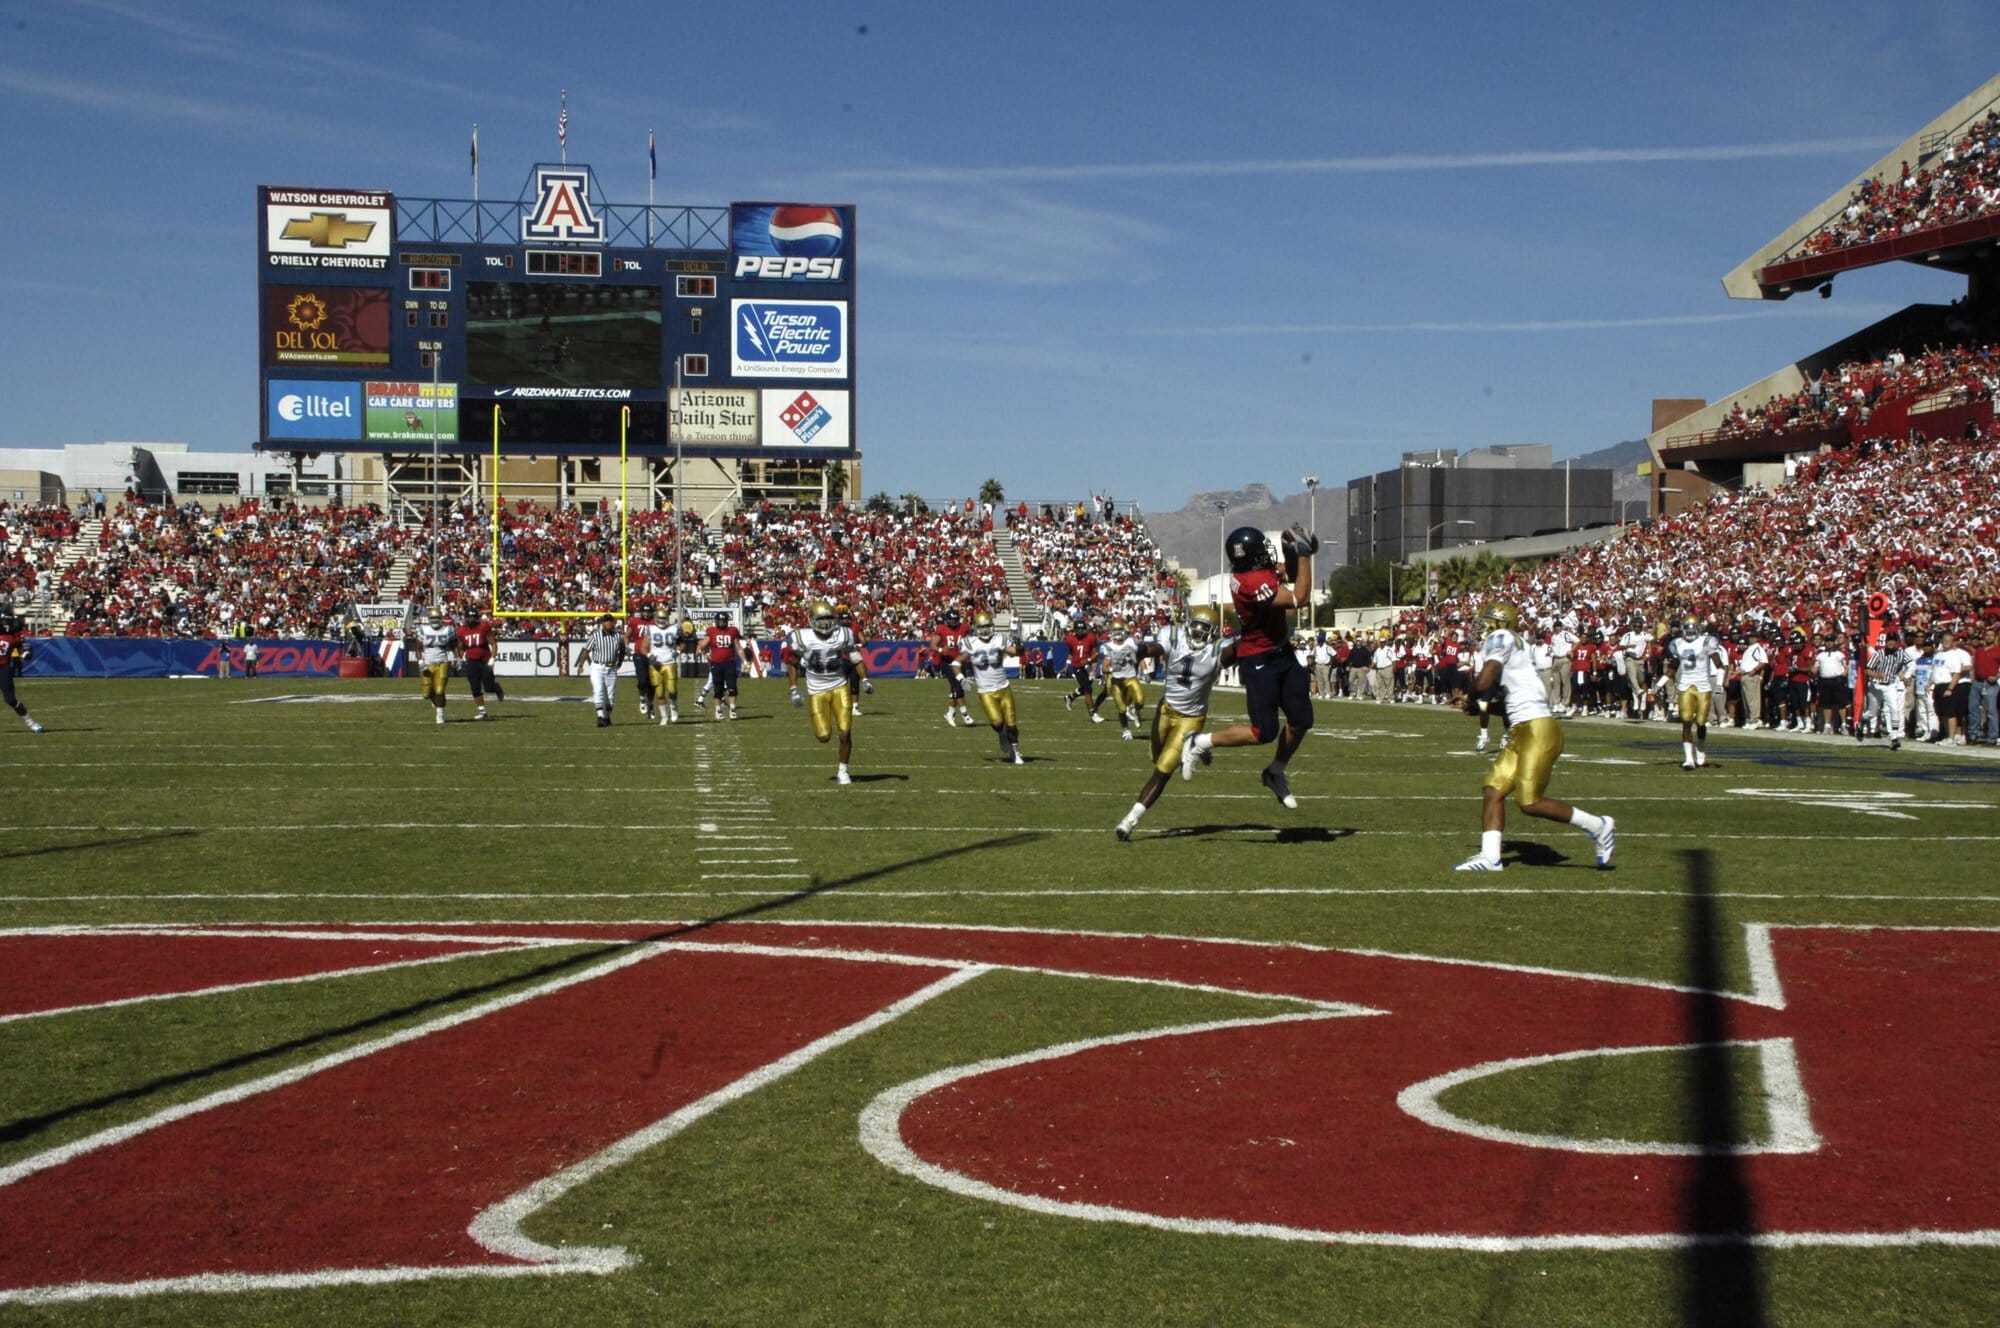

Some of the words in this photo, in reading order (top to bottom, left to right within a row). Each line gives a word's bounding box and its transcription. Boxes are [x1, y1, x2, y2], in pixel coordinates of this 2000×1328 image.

[270, 192, 317, 203] WATSON
[320, 195, 385, 206] CHEVROLET
[522, 170, 602, 241] A
[270, 255, 318, 266] O'RIELLY
[321, 257, 387, 268] CHEVROLET
[485, 257, 503, 266] TOL
[624, 260, 642, 270] TOL
[735, 256, 843, 279] PEPSI
[439, 302, 447, 310] GO
[763, 311, 817, 326] Tucson
[769, 326, 831, 340] Electric
[276, 331, 304, 349] DEL
[310, 332, 338, 349] SOL
[433, 342, 442, 350] ON
[775, 340, 830, 354] Power
[781, 366, 806, 374] Energy
[807, 366, 840, 374] Company
[512, 387, 631, 398] ARIZONAATHLETICS.COM
[680, 391, 745, 407] Arizona
[278, 394, 352, 421] alltel
[369, 398, 387, 407] CAR
[390, 398, 413, 408] CARE
[669, 409, 715, 429] Daily
[719, 410, 756, 425] Star
[369, 431, 455, 440] www.brakemaxcom
[695, 431, 727, 440] Tucson
[729, 432, 753, 442] thing
[801, 425, 821, 442] Pizza
[465, 634, 480, 647] 77
[509, 652, 532, 662] MILK
[1077, 646, 1084, 658] 7
[197, 647, 345, 673] ARZONA
